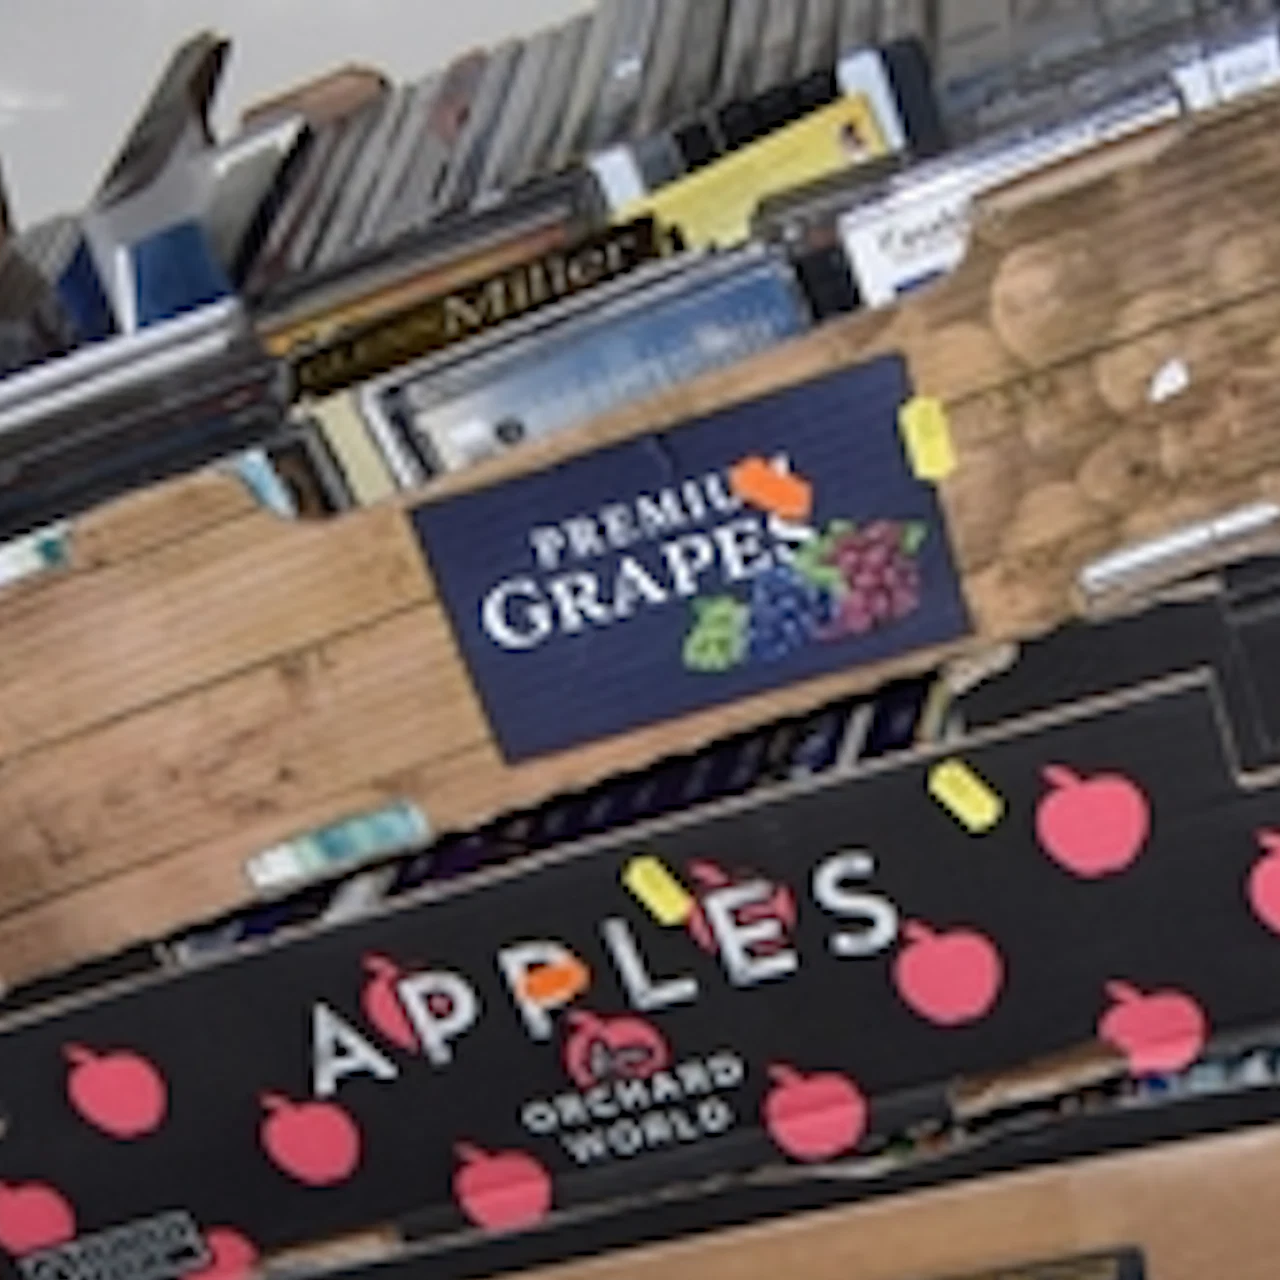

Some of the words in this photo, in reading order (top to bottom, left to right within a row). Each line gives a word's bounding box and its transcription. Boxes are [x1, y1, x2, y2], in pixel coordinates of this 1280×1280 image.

[442, 240, 638, 338] Miller
[529, 452, 788, 570] PREMIU
[480, 512, 818, 650] GRAPES
[310, 850, 898, 1096] APPLES
[520, 1052, 745, 1134] ORCHARD
[560, 1095, 732, 1166] WORLD
